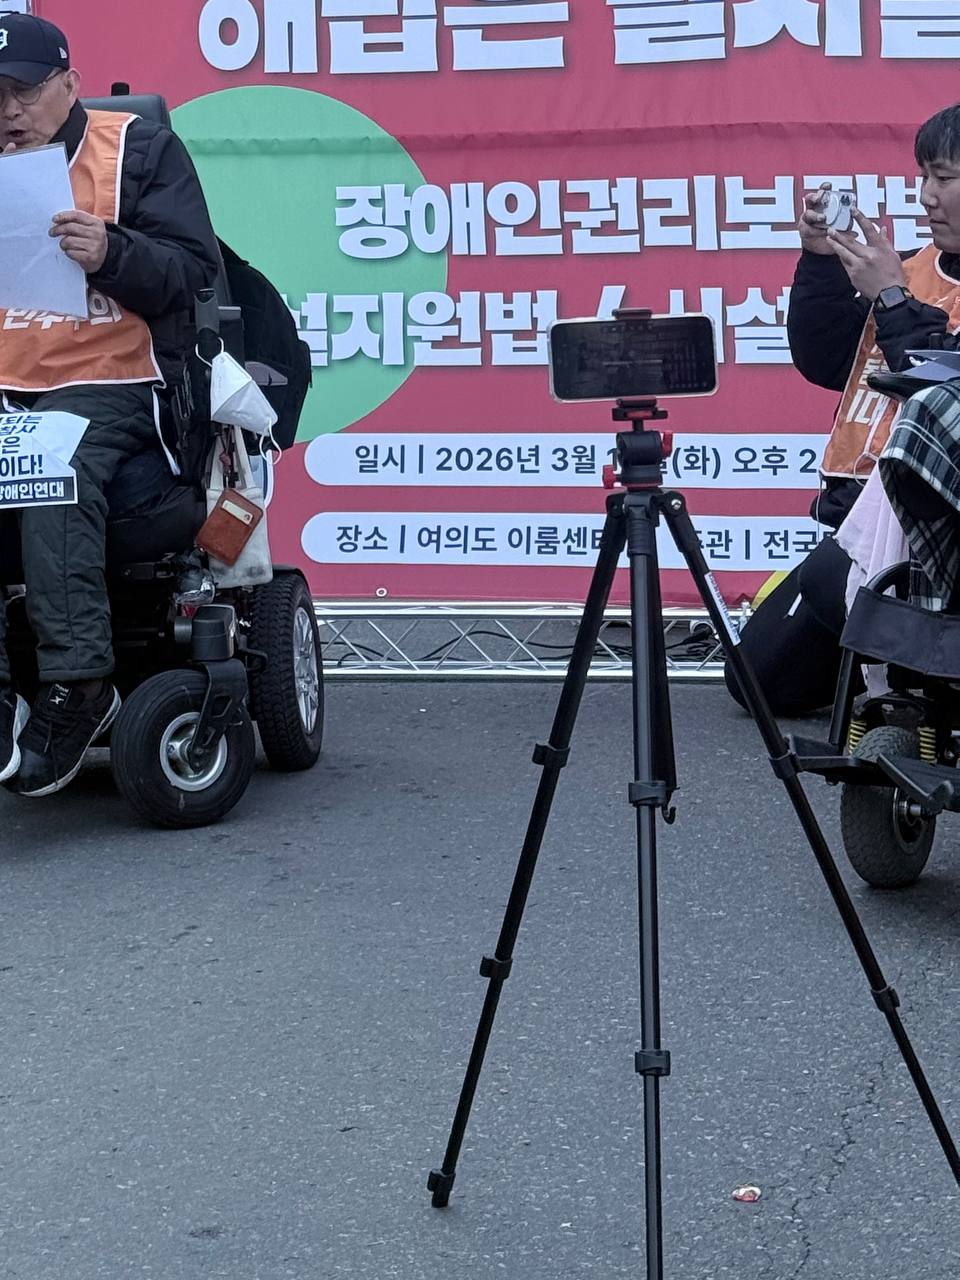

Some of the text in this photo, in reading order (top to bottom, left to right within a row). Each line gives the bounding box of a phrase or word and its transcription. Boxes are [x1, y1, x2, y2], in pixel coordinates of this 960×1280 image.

[355, 444, 406, 475] 일시
[435, 444, 541, 475] 2026년
[551, 444, 597, 475] 3월
[606, 445, 722, 479] 1(화)
[732, 445, 789, 477] 오후
[335, 524, 389, 554] 장소
[416, 524, 498, 554] 여의도
[697, 529, 733, 561] 관
[762, 530, 836, 561] 전국
